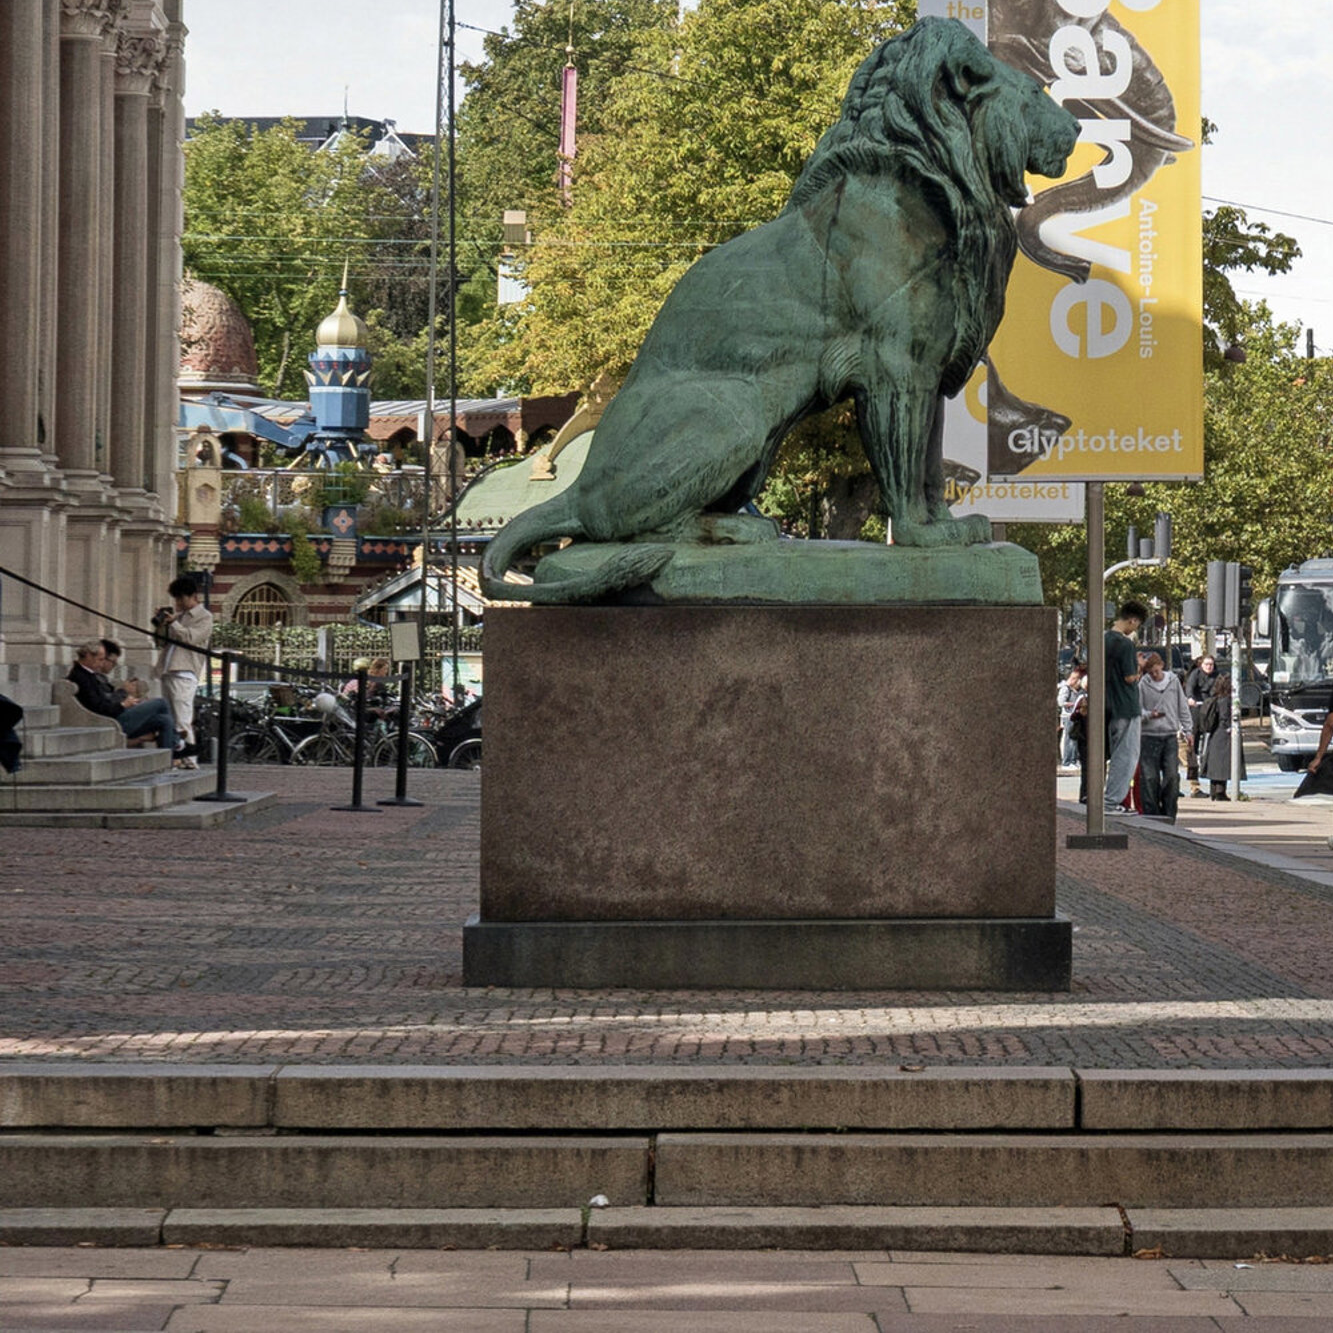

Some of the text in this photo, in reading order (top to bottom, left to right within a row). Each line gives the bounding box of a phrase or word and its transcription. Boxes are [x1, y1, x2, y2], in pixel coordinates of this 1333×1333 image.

[946, 0, 984, 20] the
[1138, 197, 1159, 360] Antoine-Louis
[1007, 427, 1184, 460] Glyptoteket
[944, 478, 1070, 505] lyptoteket
